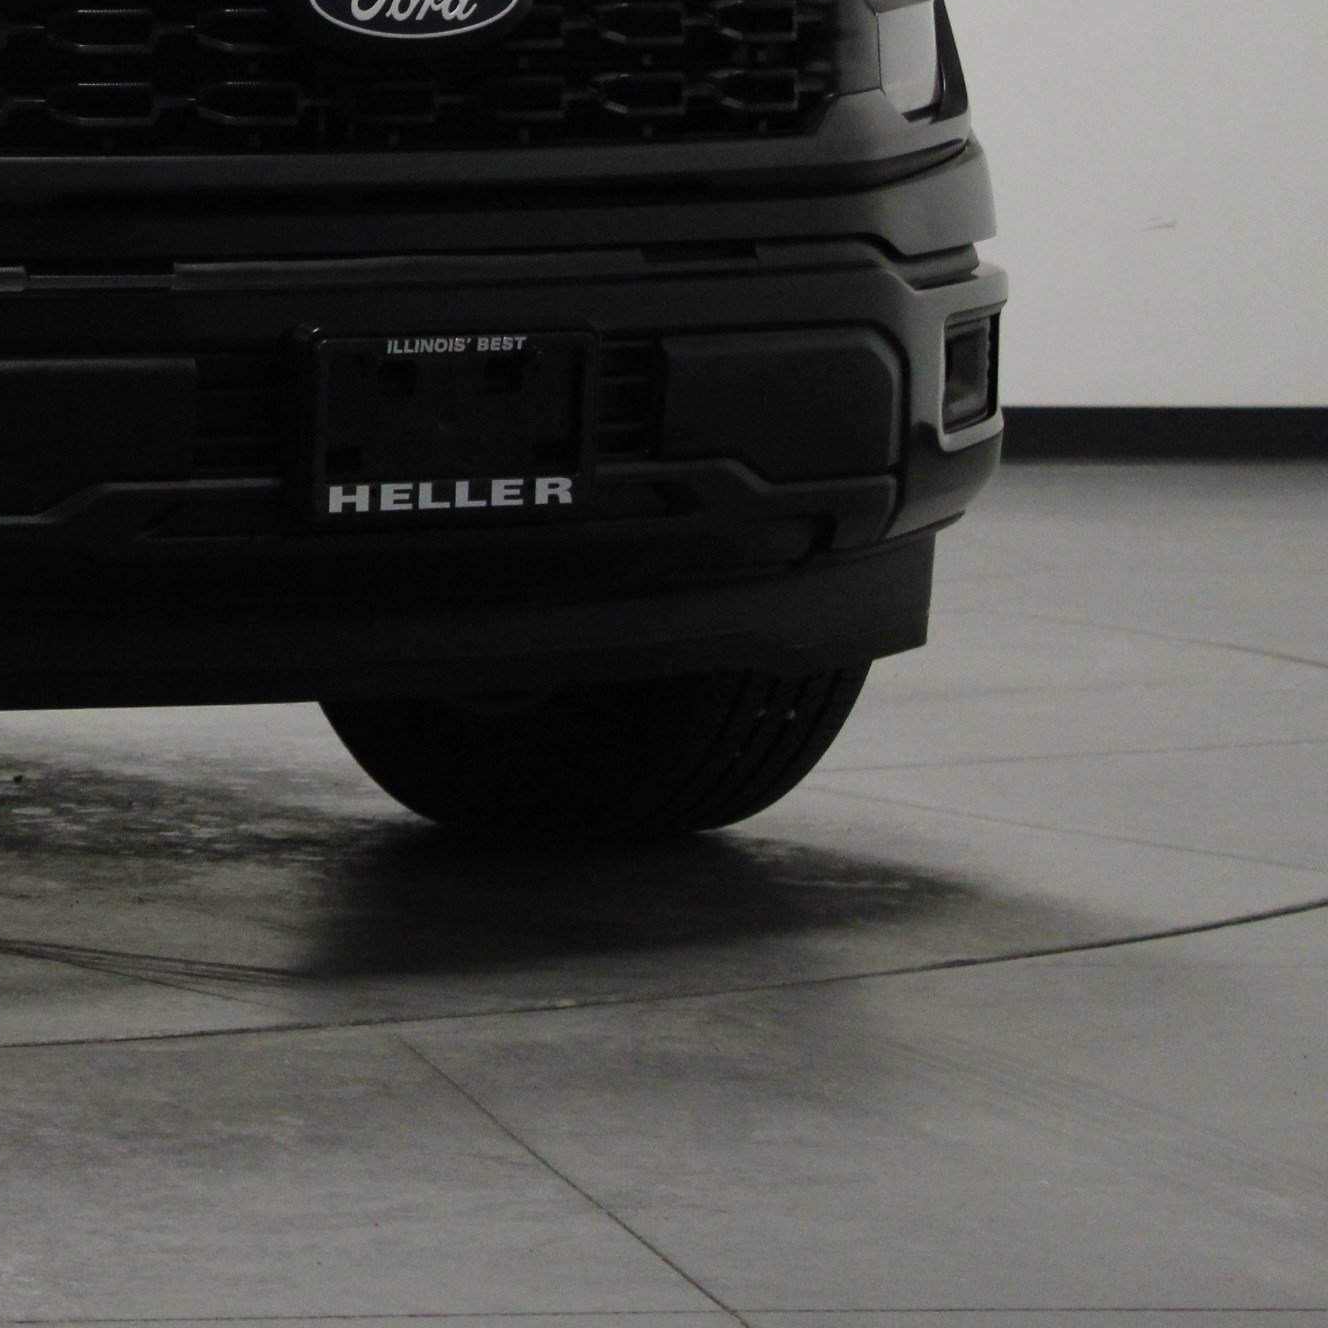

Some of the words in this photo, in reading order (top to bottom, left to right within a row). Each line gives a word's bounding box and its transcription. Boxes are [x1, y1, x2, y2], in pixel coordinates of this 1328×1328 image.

[387, 337, 472, 354] ILLINOIS'
[476, 336, 527, 351] BEST
[328, 476, 574, 514] HELLER
